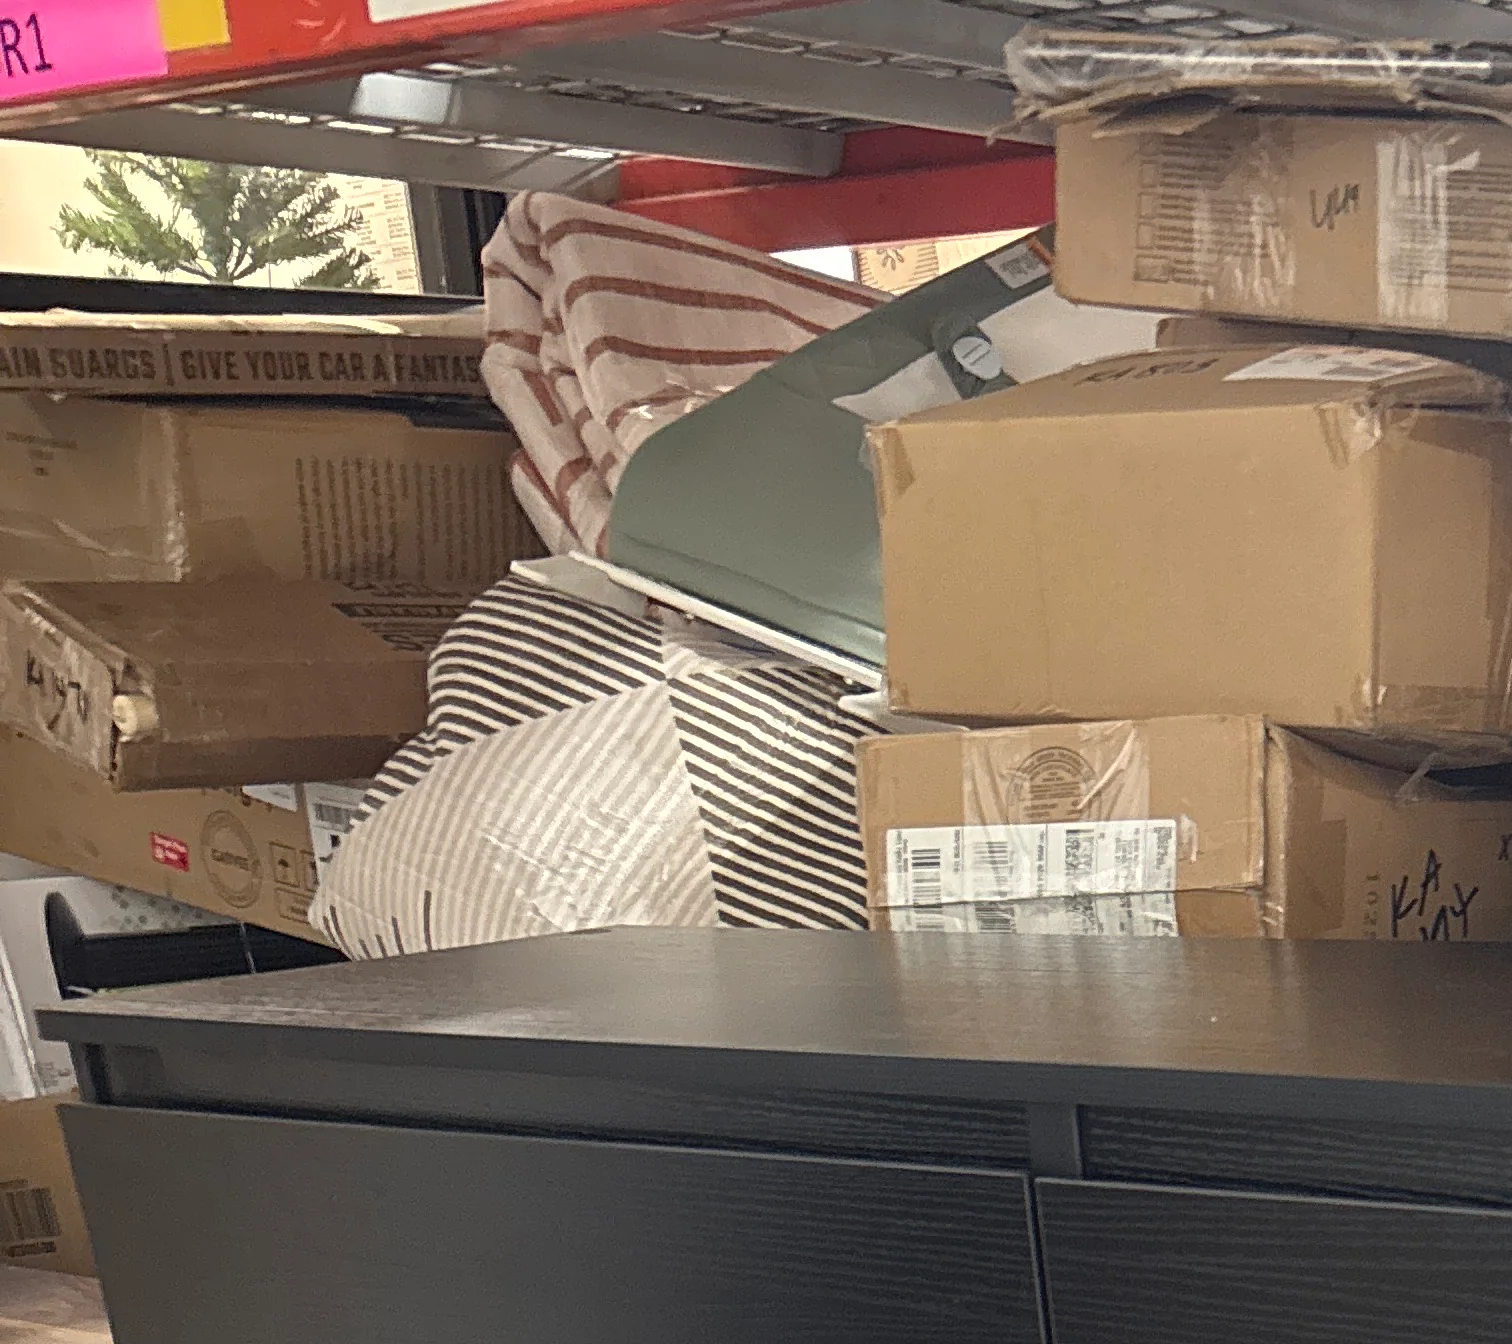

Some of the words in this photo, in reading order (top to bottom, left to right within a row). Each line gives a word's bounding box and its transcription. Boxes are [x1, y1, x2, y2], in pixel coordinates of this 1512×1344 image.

[180, 348, 238, 381] GIVE
[246, 349, 314, 381] YOUR
[319, 350, 365, 382] CAR
[372, 352, 389, 382] A
